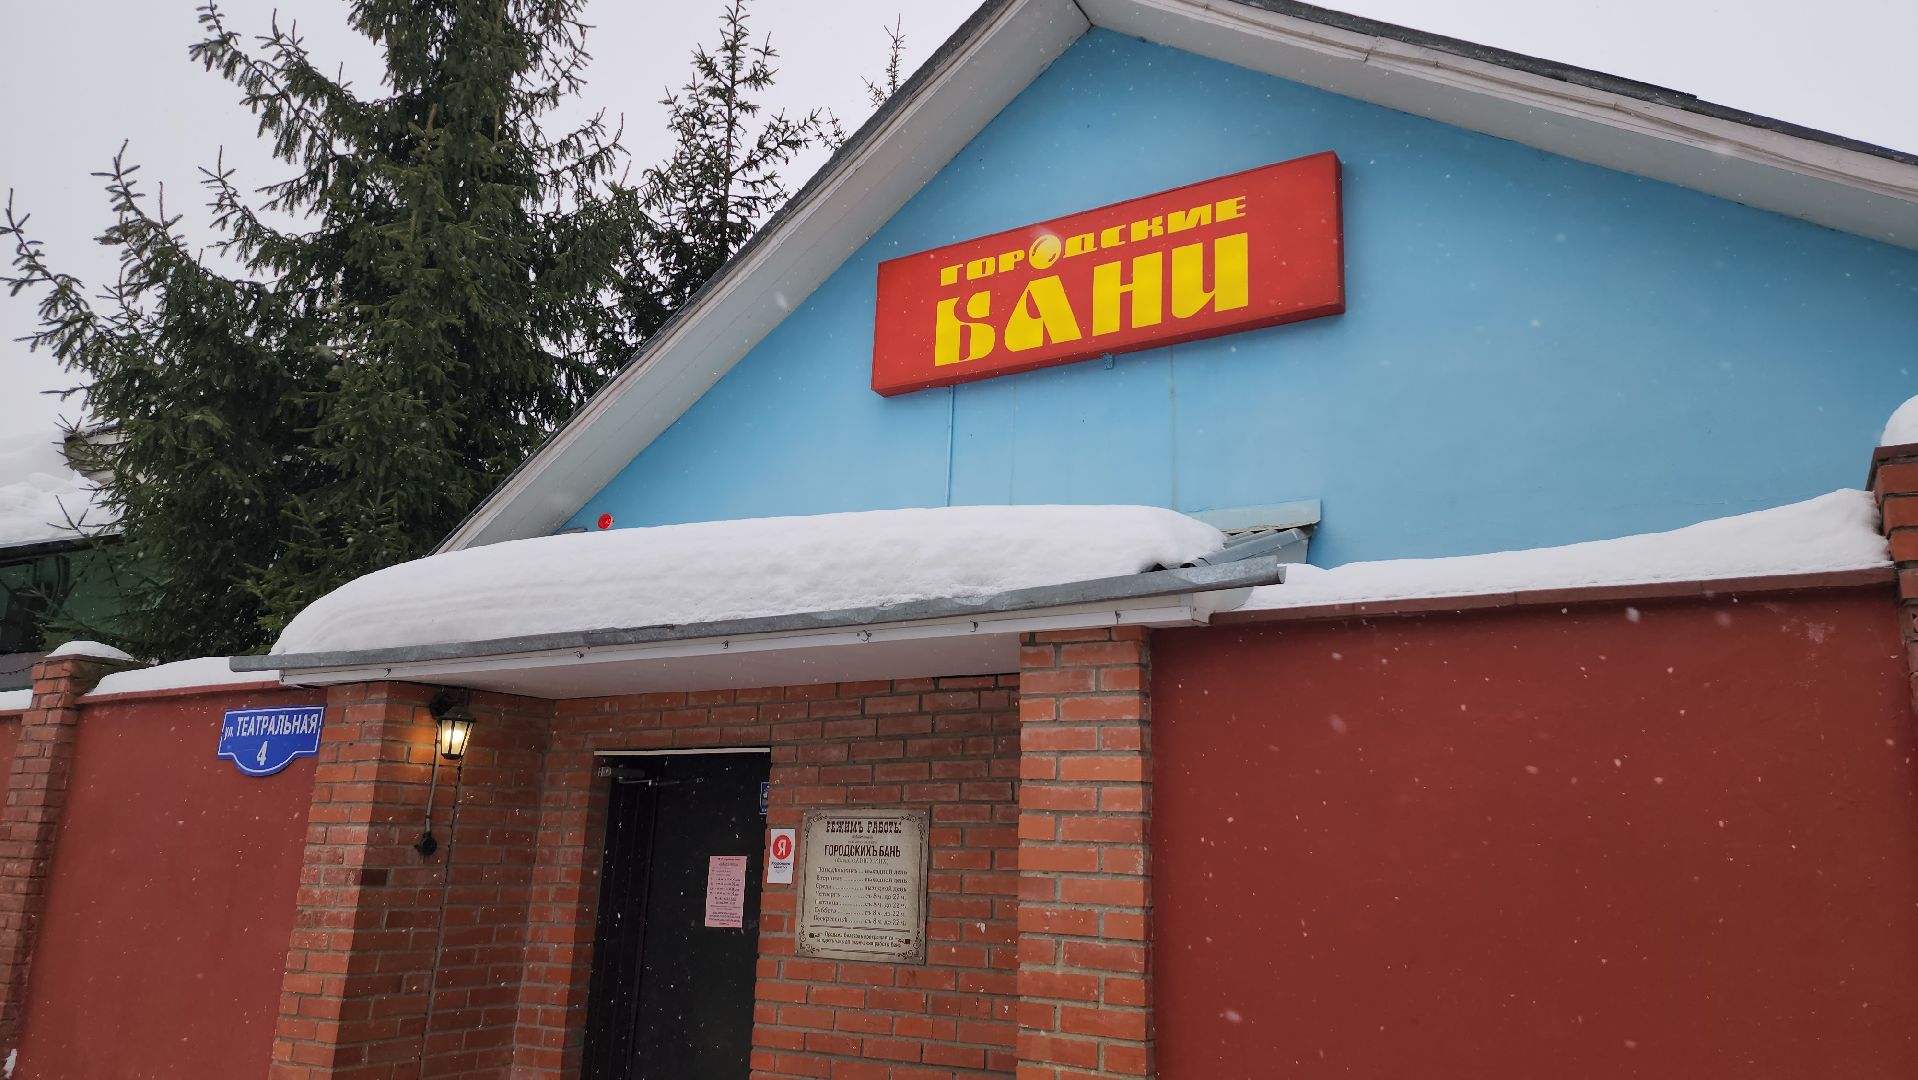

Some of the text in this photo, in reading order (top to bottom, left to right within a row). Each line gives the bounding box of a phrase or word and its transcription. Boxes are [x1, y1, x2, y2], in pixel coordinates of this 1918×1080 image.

[940, 195, 1246, 287] ГОРОДСКИЕ
[935, 232, 1248, 366] БАНИ
[236, 713, 319, 737] ТЕАТРАЛЬНАЯ
[256, 740, 268, 766] 4
[776, 839, 787, 857] Я
[824, 845, 901, 858] ГОРОДСКИХЪ БАНЬ
